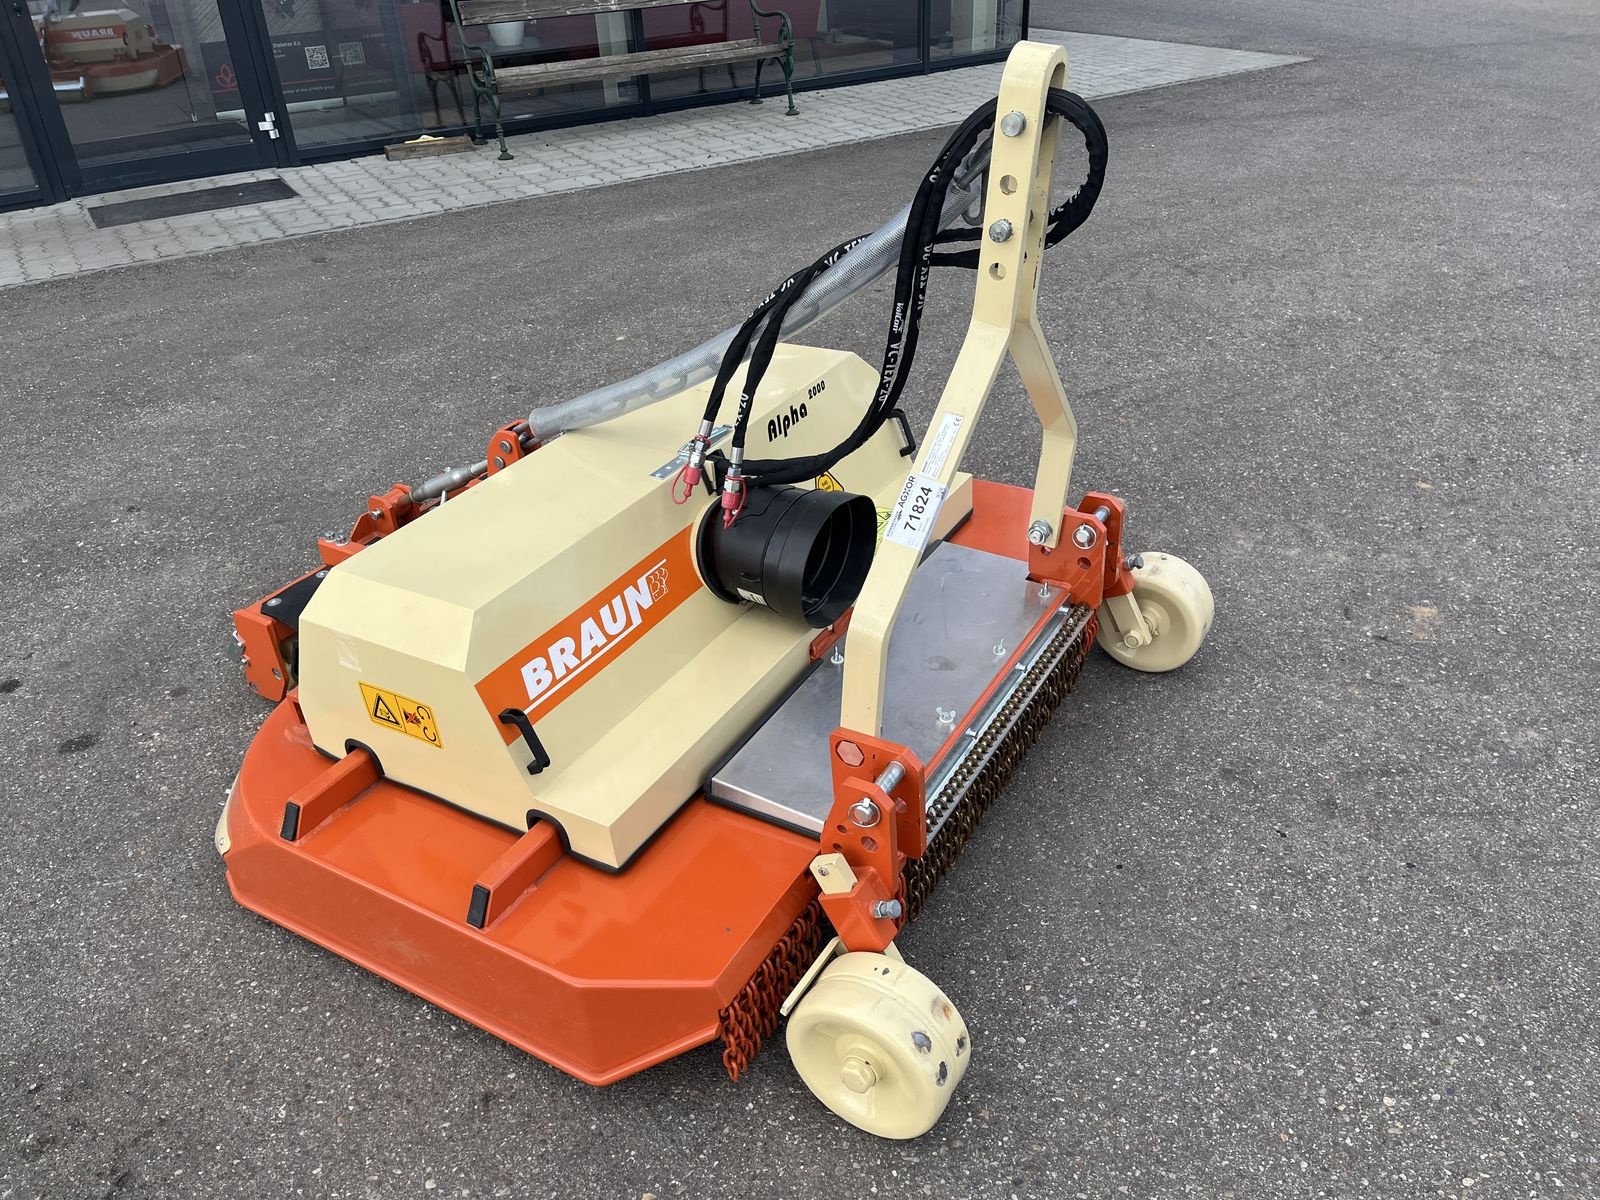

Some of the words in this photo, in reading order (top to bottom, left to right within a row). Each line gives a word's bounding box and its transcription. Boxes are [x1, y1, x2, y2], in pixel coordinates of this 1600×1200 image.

[767, 402, 808, 443] Alpha
[807, 380, 826, 400] 2000
[898, 475, 916, 508] AGXOR
[903, 486, 933, 531] 71824
[520, 575, 654, 701] BRAUN
